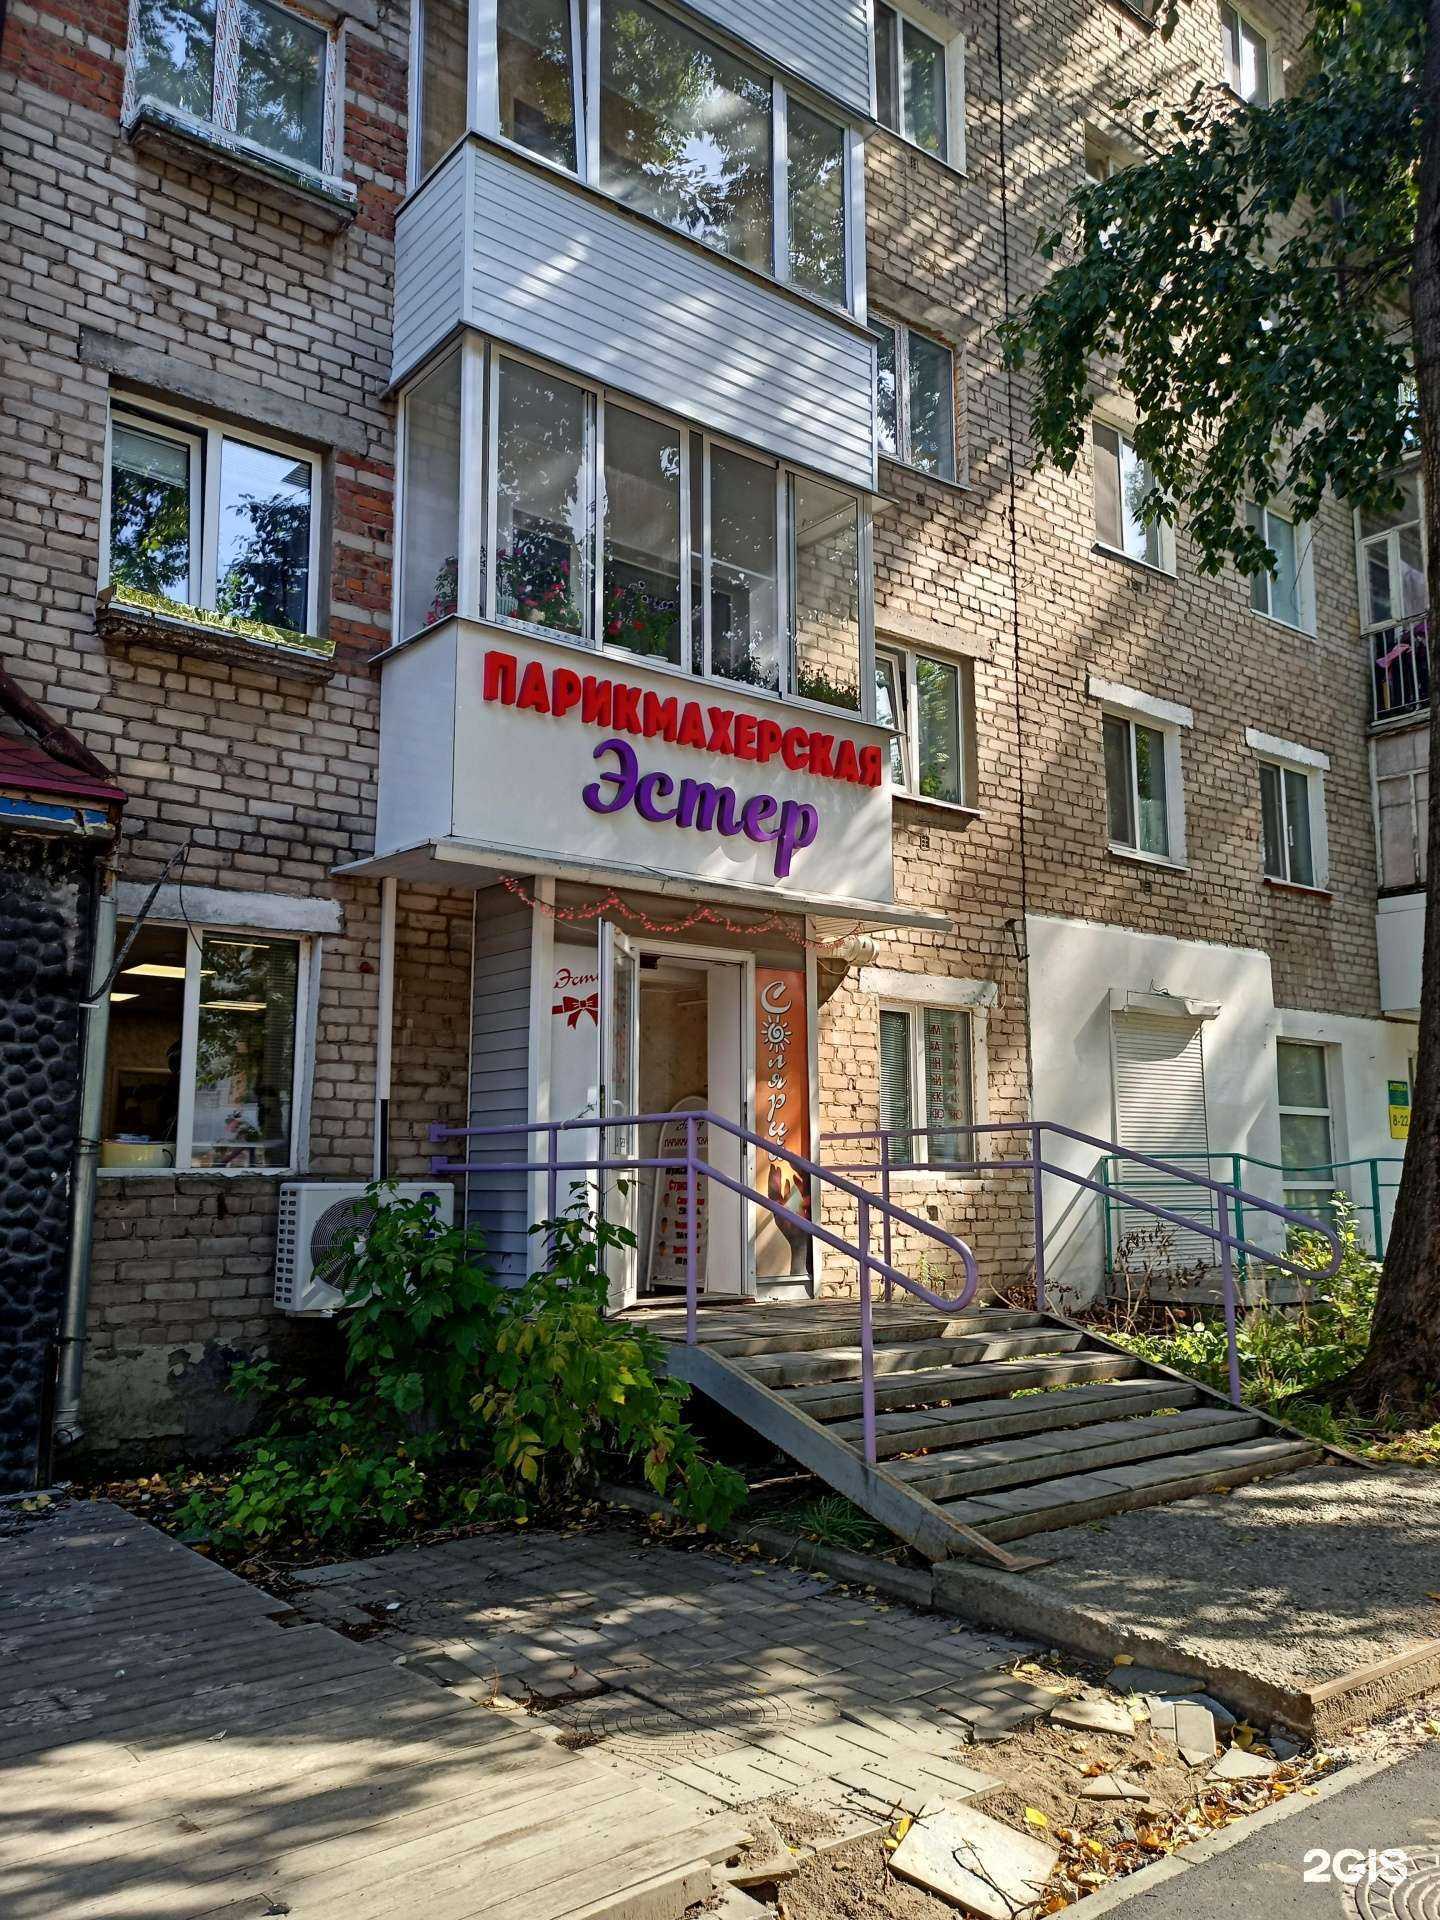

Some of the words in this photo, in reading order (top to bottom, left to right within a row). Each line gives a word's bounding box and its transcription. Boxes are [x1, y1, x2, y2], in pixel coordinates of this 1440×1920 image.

[483, 650, 882, 787] ПАРИКМАХЕРСКАЯ
[582, 738, 820, 878] Эстер
[553, 968, 599, 989] Эст
[930, 1024, 945, 1128] МАНИКЮ
